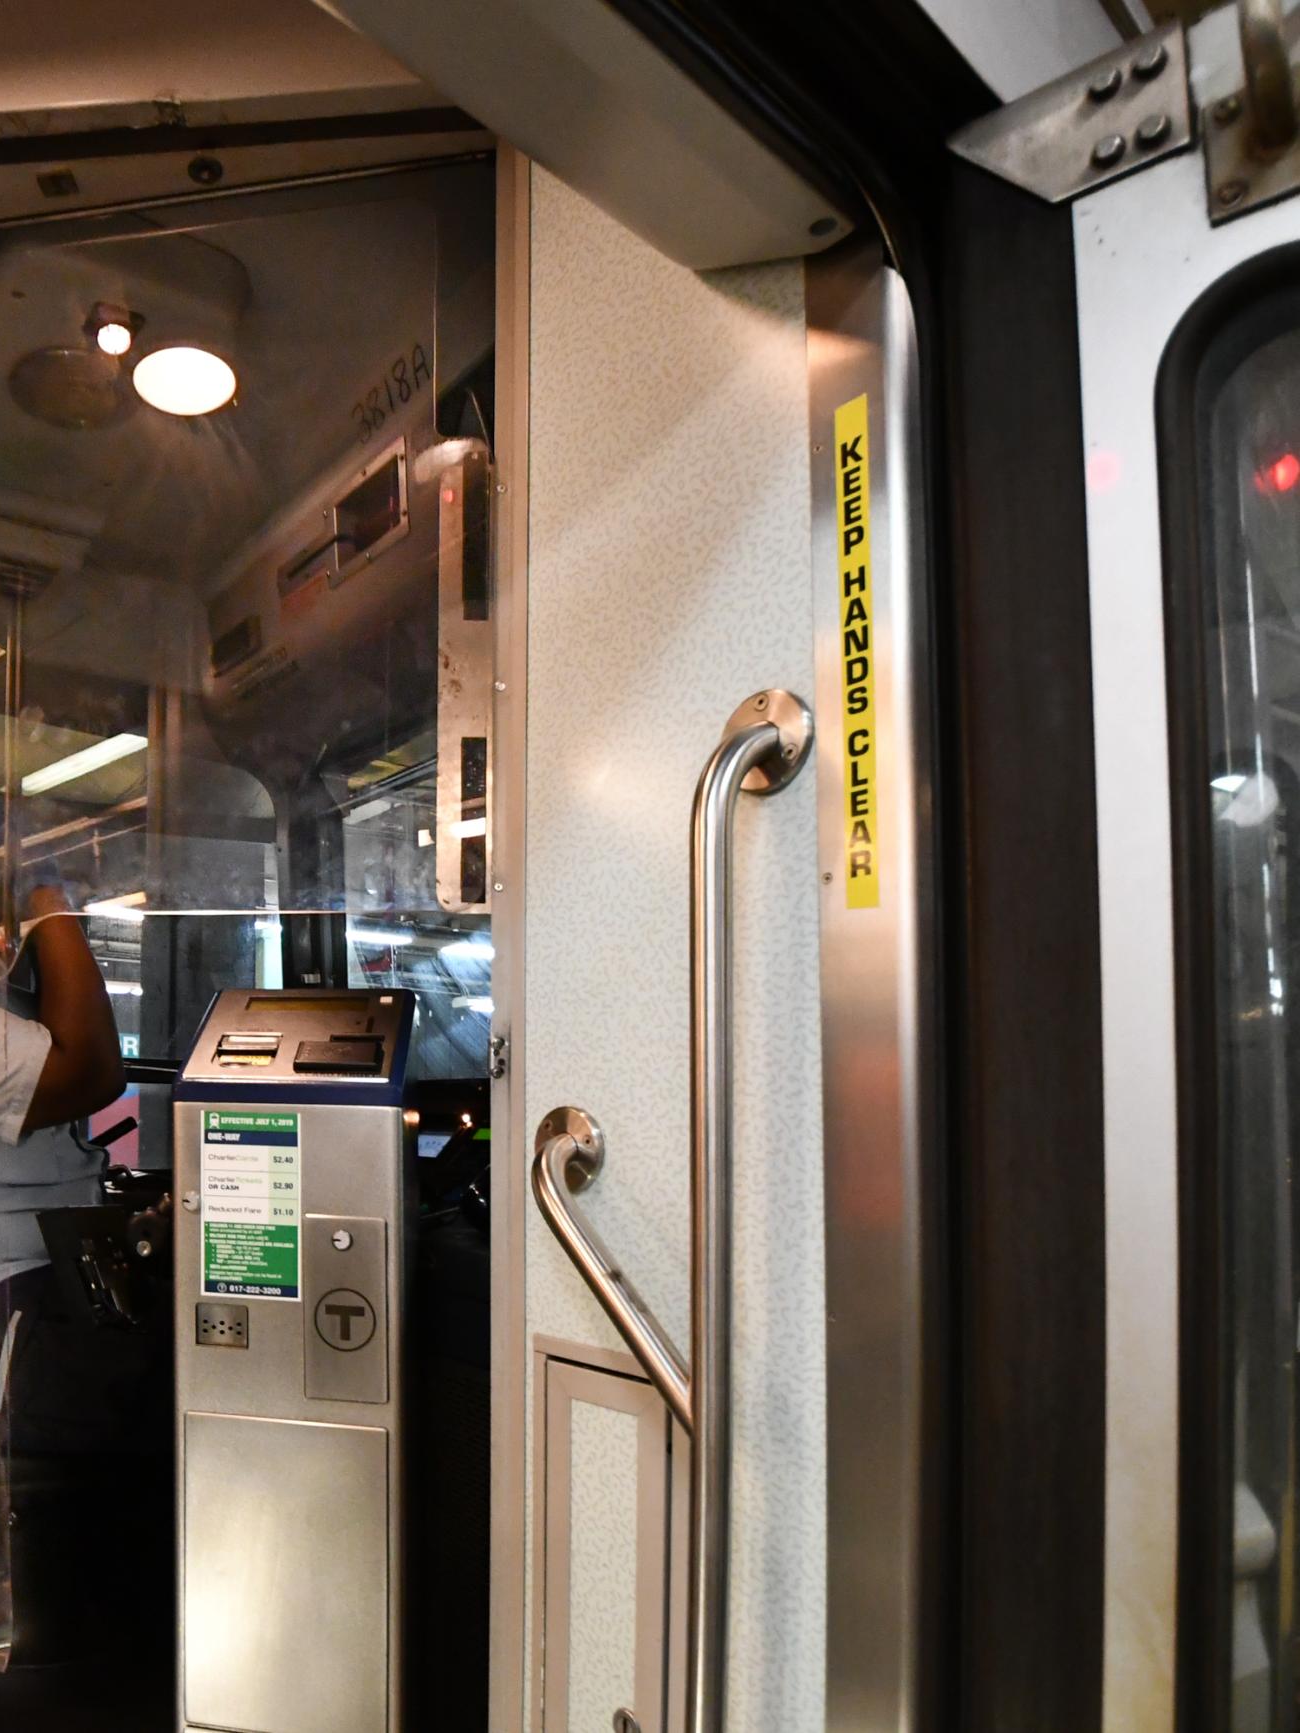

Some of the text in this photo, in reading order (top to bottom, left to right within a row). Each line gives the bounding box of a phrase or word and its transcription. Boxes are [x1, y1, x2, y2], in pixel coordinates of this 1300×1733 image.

[351, 343, 431, 438] 3818A
[841, 435, 872, 878] KEEP HANDS CLEAR
